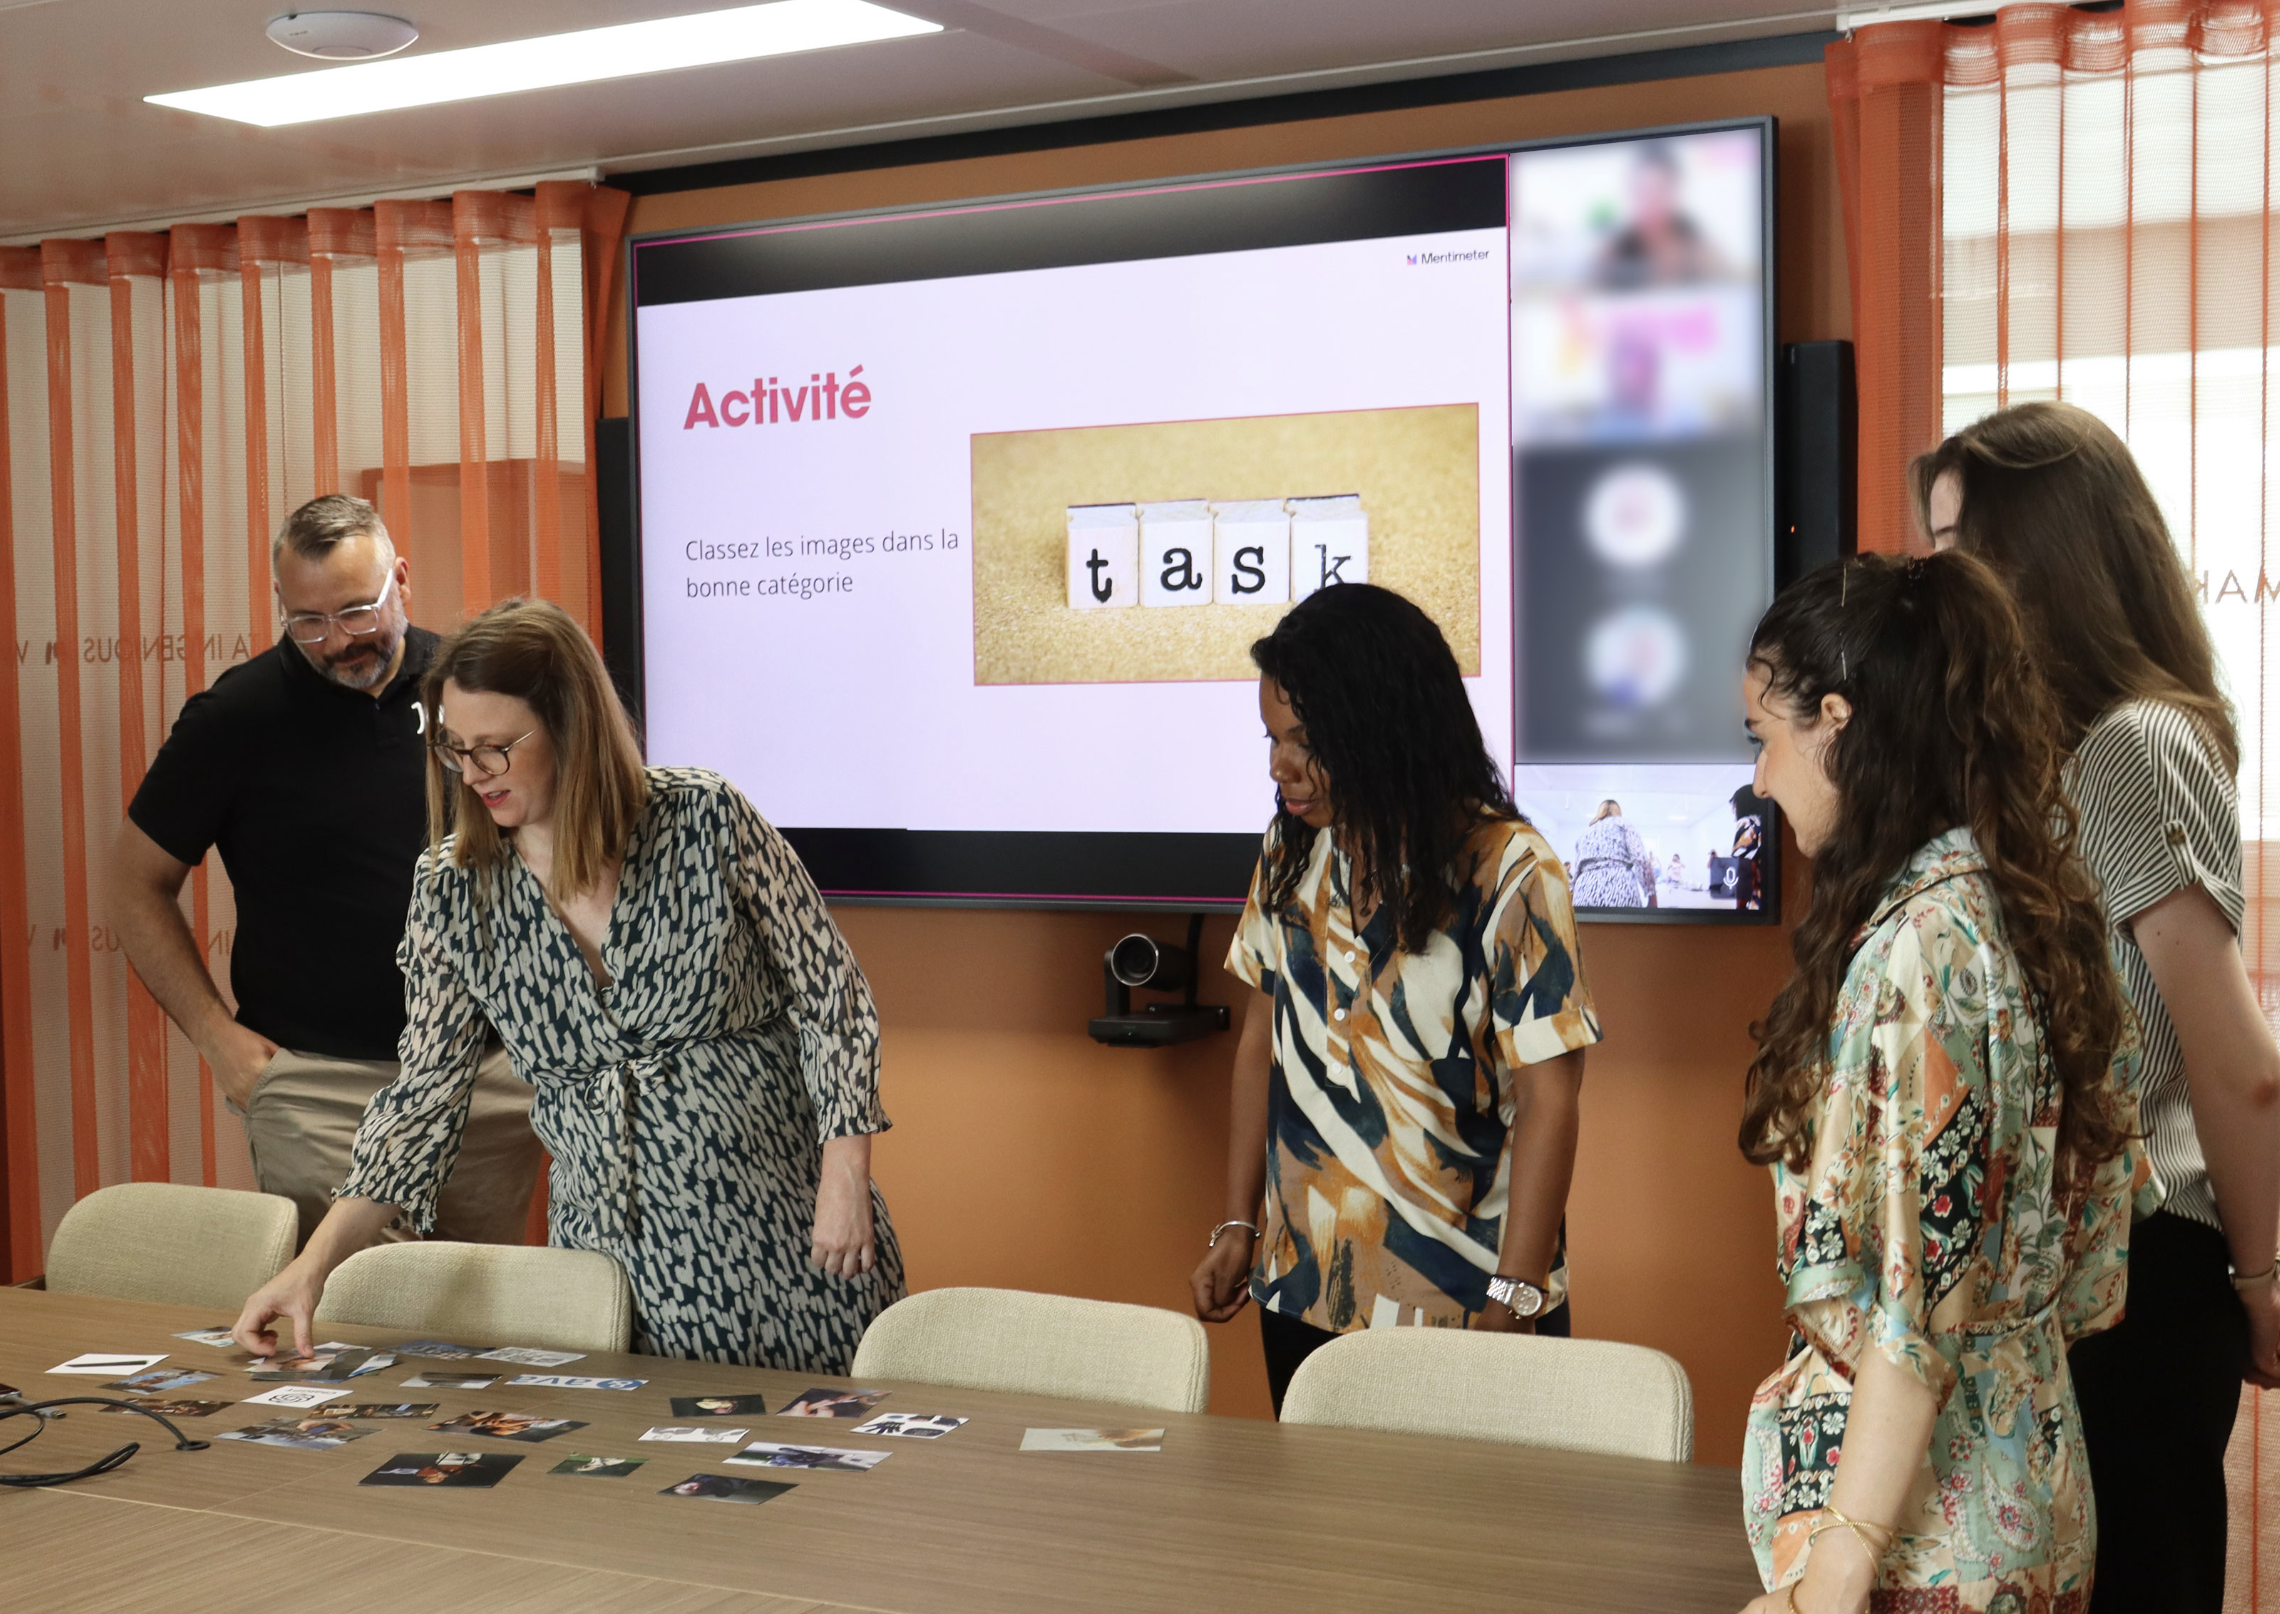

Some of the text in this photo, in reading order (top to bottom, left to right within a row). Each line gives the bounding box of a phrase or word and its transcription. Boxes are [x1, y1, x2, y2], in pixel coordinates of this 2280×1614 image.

[1421, 249, 1489, 265] Mentimeter
[683, 363, 872, 430] Activité
[685, 528, 959, 561] Classez les images dans la
[686, 571, 854, 600] bonne catégorie
[1086, 543, 1352, 603] task
